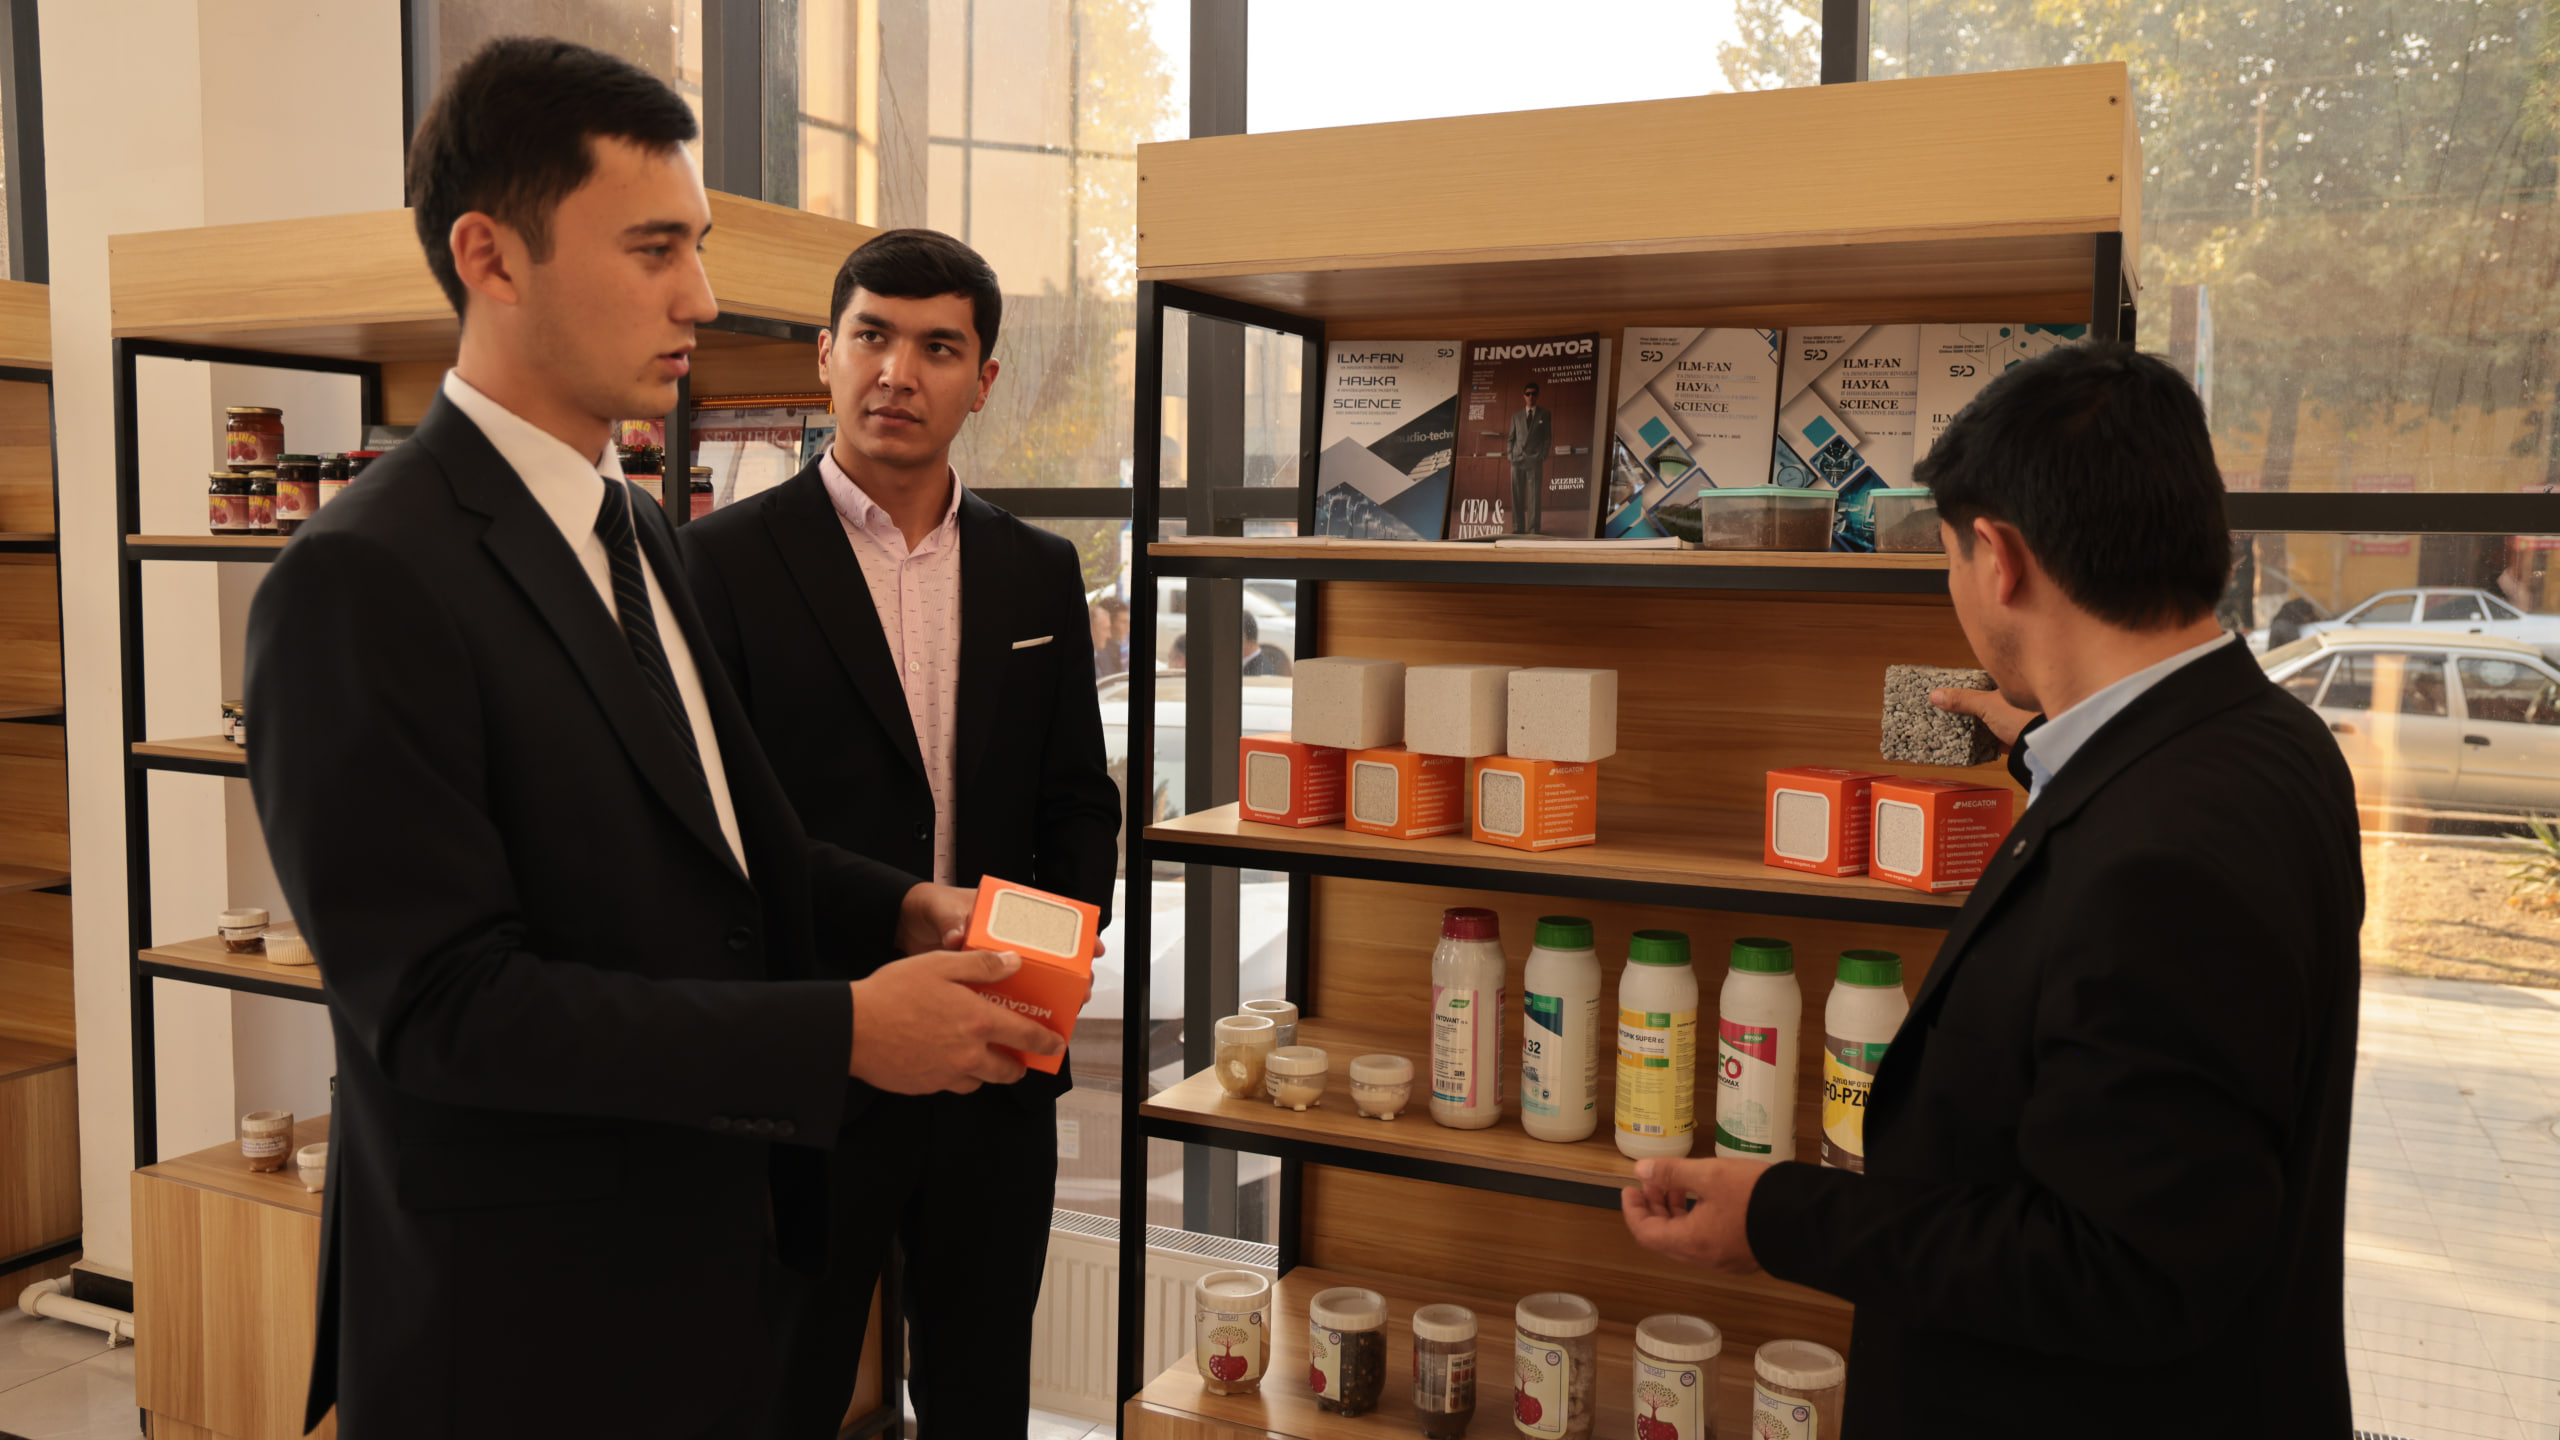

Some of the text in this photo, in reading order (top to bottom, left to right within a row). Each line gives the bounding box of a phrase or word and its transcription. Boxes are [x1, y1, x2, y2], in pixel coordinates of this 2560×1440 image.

[1474, 339, 1593, 361] INNOVATOR
[1337, 353, 1404, 364] ILM-FAN
[1843, 358, 1902, 369] ILM-FAN
[1677, 361, 1732, 372] ILM-FAN
[1333, 399, 1402, 409] SCIENCE
[1673, 401, 1729, 413] SCIENCE
[1839, 399, 1899, 410] SCIENCE
[1460, 498, 1505, 524] CEO &
[1961, 799, 1997, 808] MEGATON
[979, 991, 1052, 1020] MEGATON
[1635, 1034, 1657, 1044] SUPER
[1527, 1039, 1541, 1055] 32
